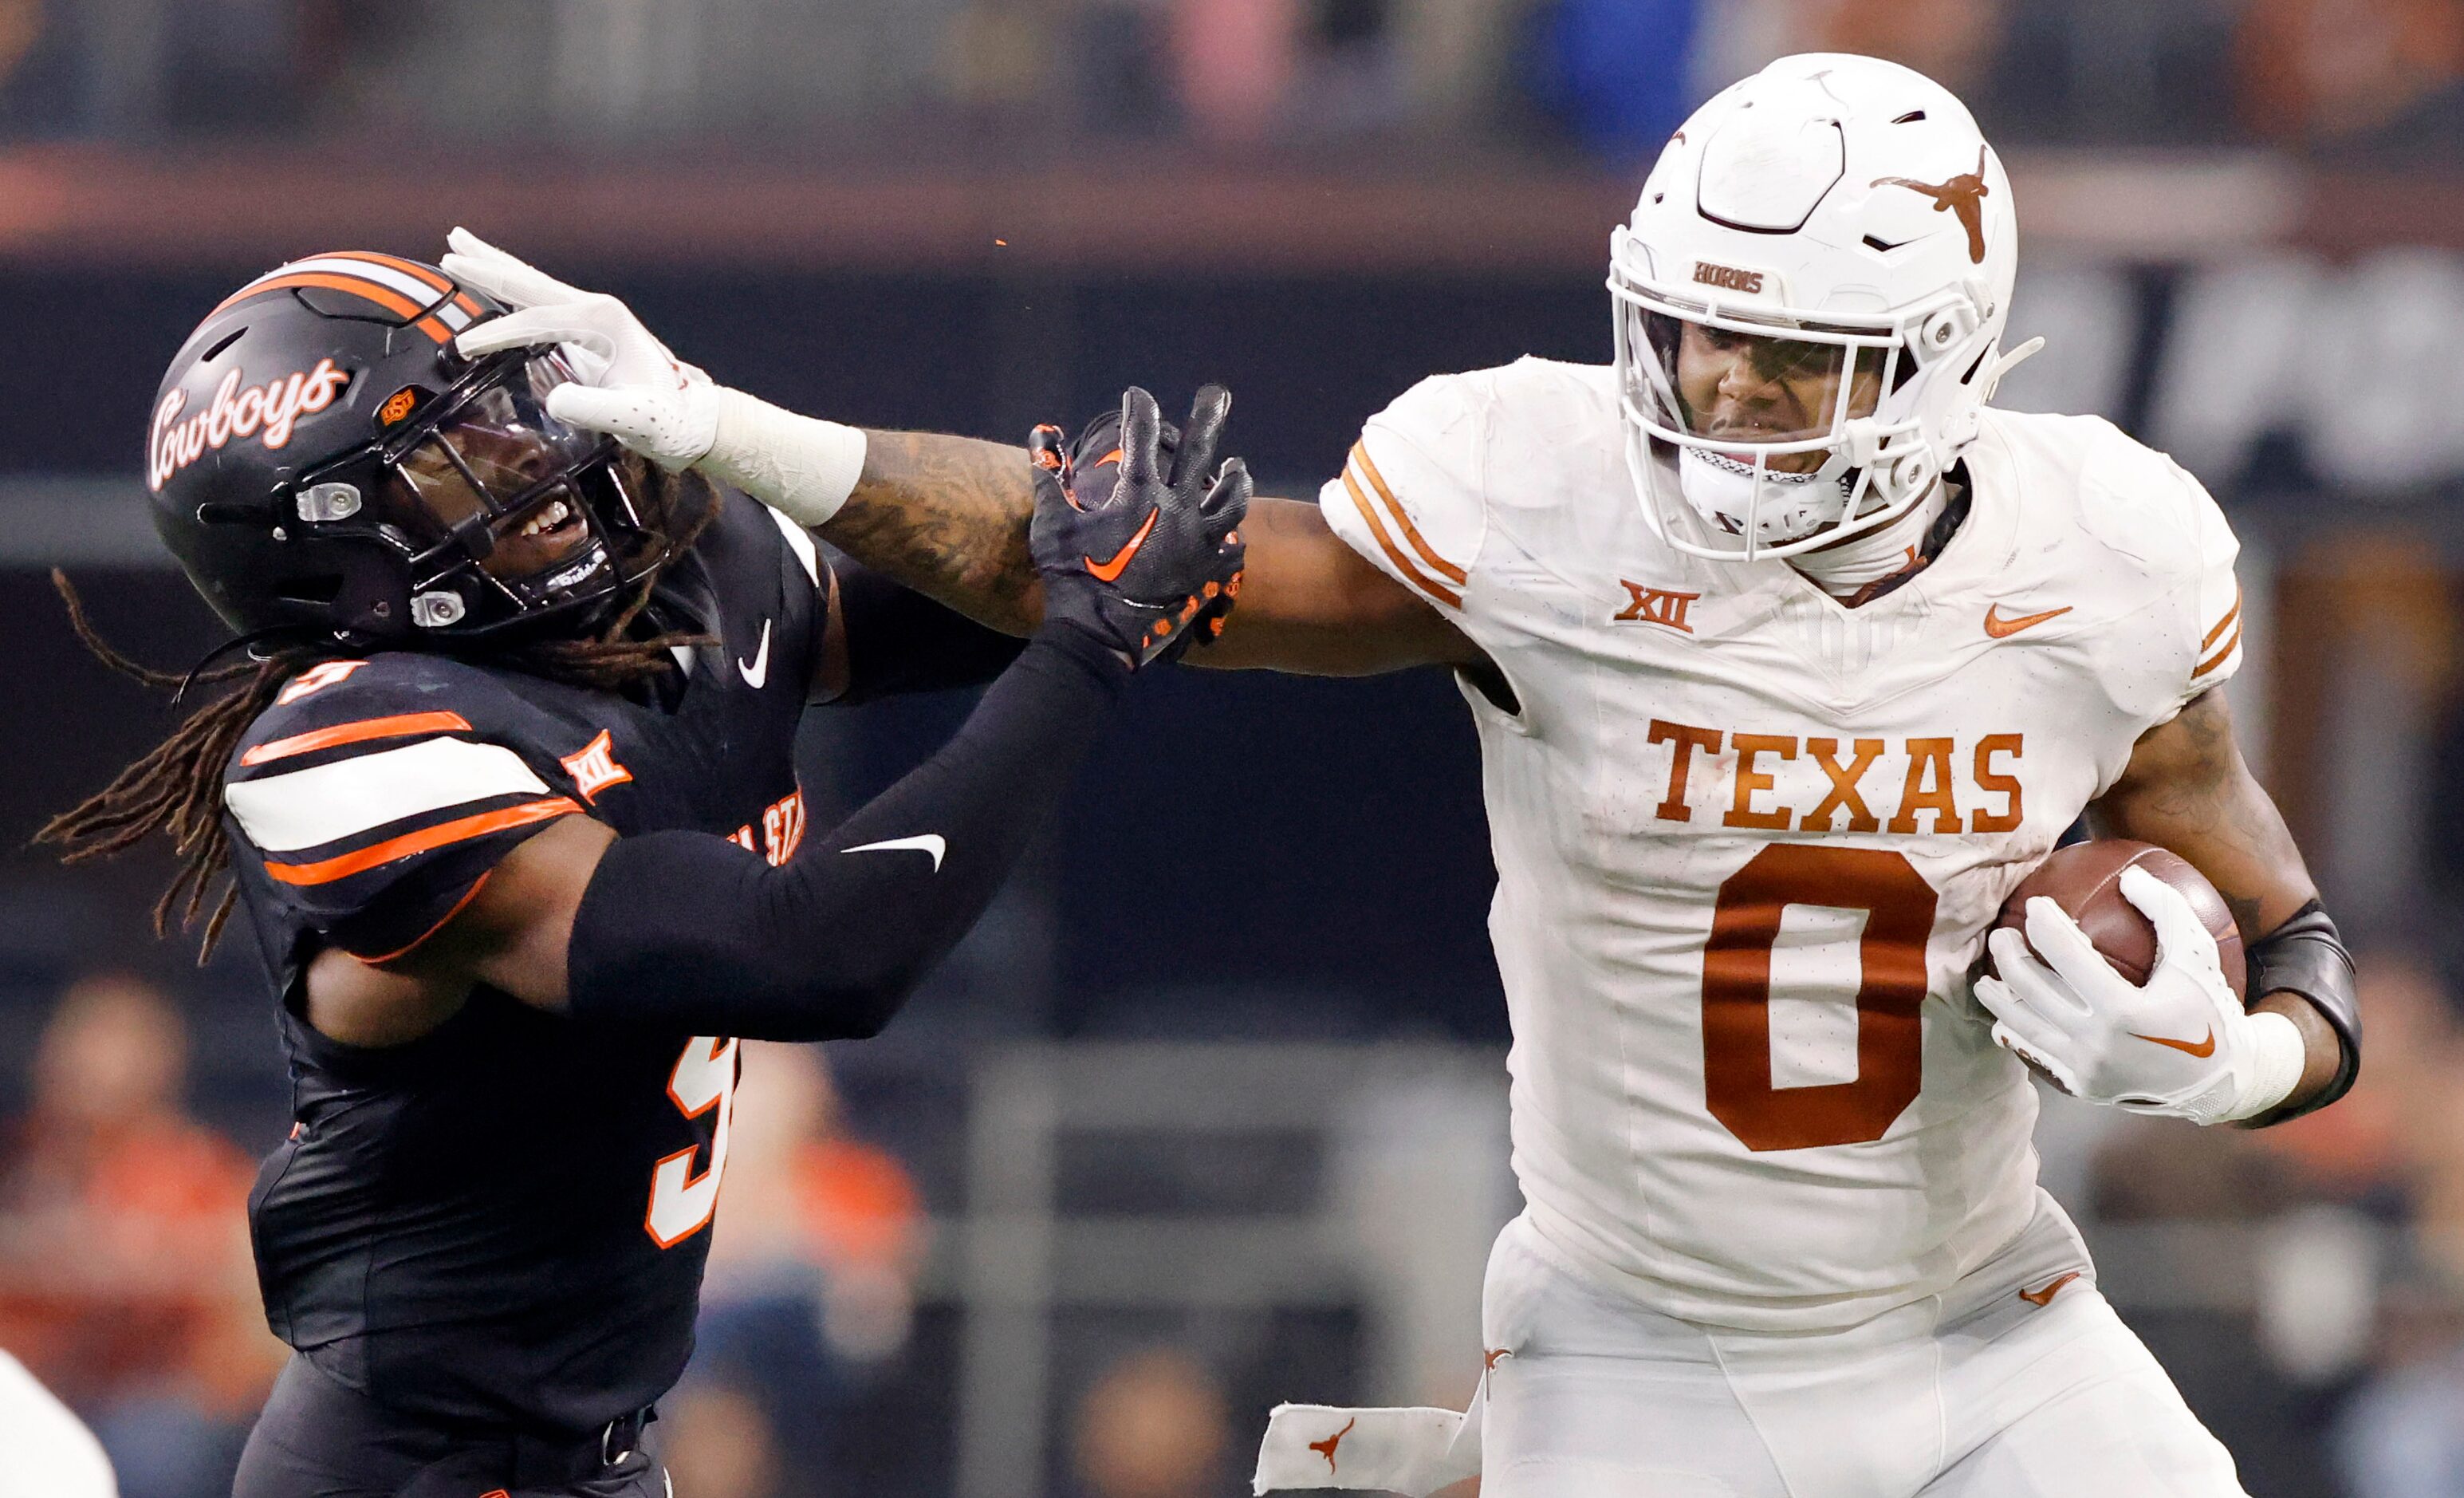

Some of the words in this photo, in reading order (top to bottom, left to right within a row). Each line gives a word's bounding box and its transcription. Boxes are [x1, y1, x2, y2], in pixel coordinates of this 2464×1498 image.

[1692, 261, 1764, 294] HORNS
[147, 357, 349, 491] Cowboys
[1613, 578, 1701, 634] XII
[561, 731, 631, 802] XII
[1647, 719, 2024, 834] TEXAS
[1702, 842, 1939, 1153] 0
[644, 1035, 740, 1250] 9
